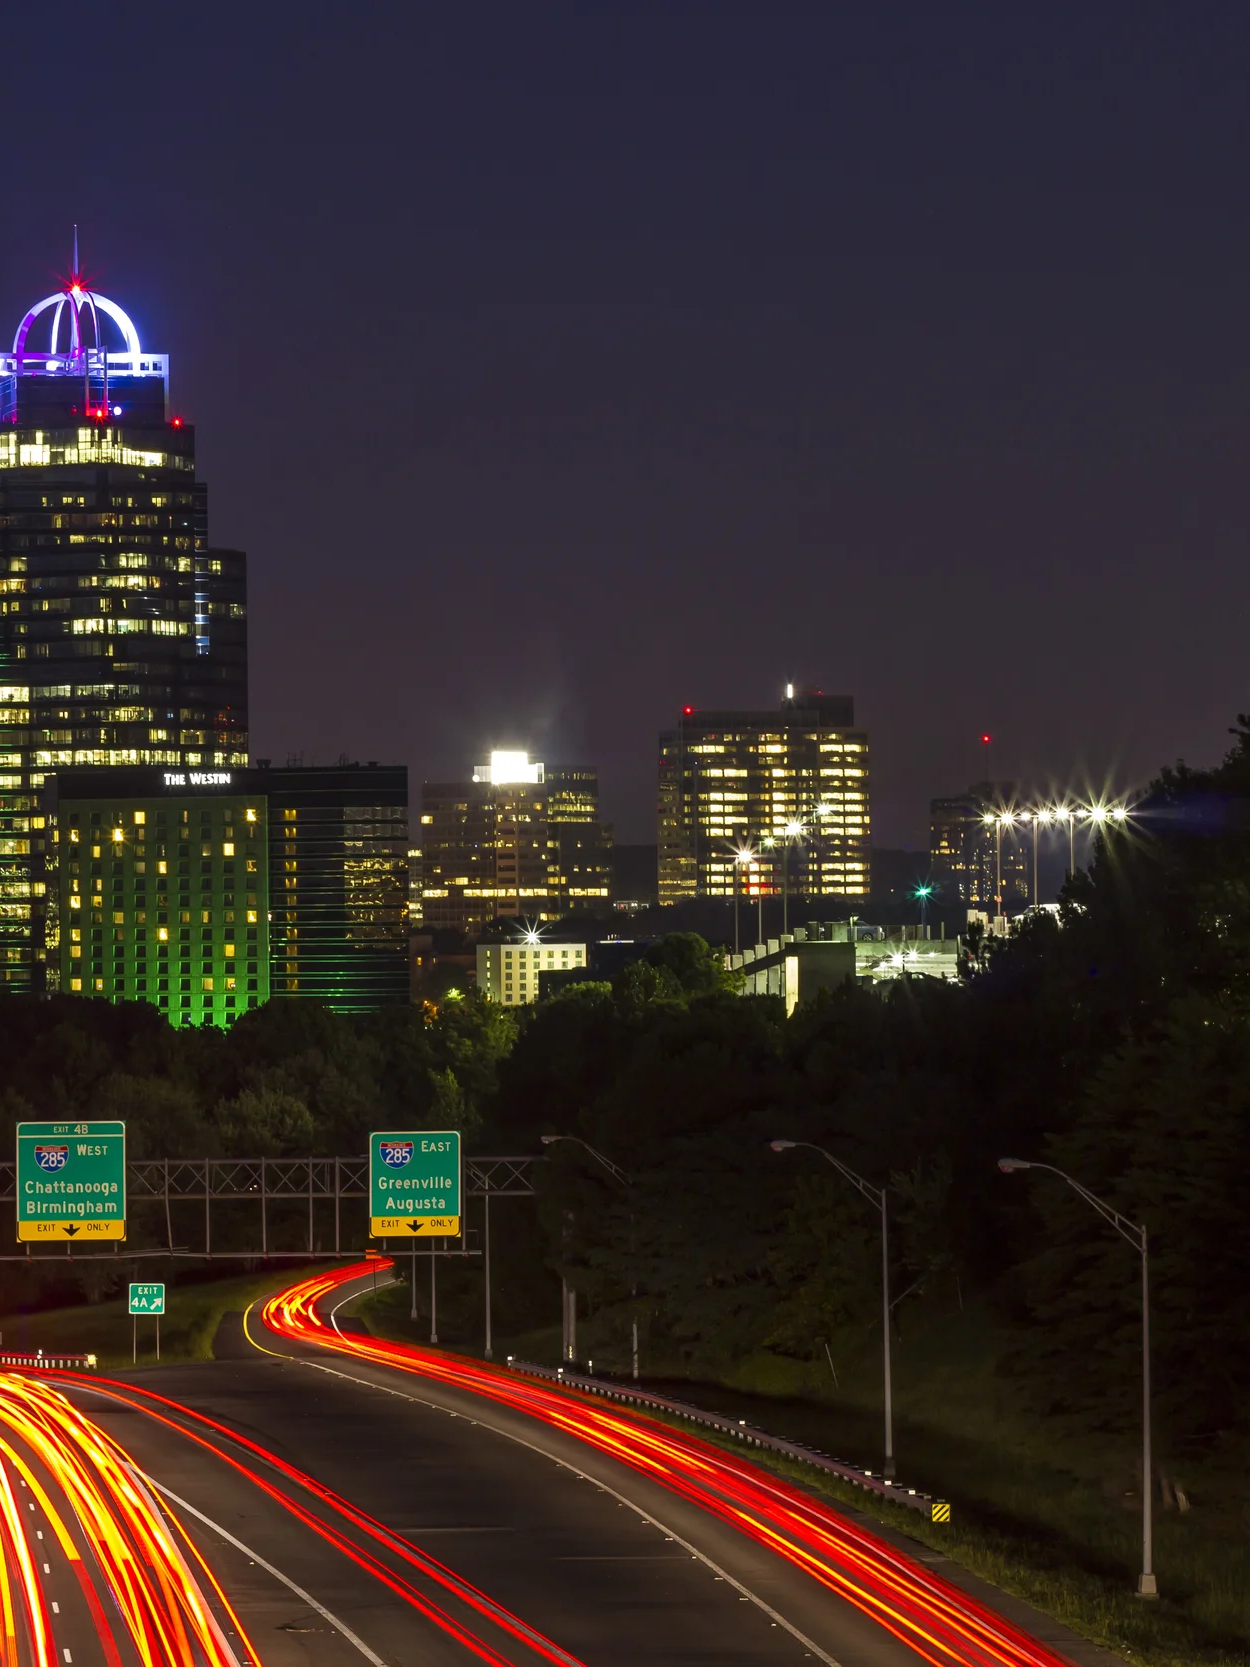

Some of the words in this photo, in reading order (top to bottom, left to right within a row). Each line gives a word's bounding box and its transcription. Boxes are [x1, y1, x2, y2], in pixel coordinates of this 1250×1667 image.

[164, 773, 186, 785] THE
[189, 773, 230, 784] WESTIN
[74, 1125, 88, 1134] 4B
[77, 1144, 108, 1155] WEST
[422, 1141, 450, 1152] EAST
[41, 1152, 65, 1167] 285
[386, 1149, 410, 1163] 285
[25, 1181, 118, 1196] Chattanooga
[378, 1177, 452, 1189] Greenville
[27, 1201, 117, 1216] Birmingham
[386, 1197, 446, 1212] Augusta
[87, 1223, 110, 1231] ONLY
[431, 1219, 453, 1227] ONLY
[132, 1297, 148, 1307] 4A
